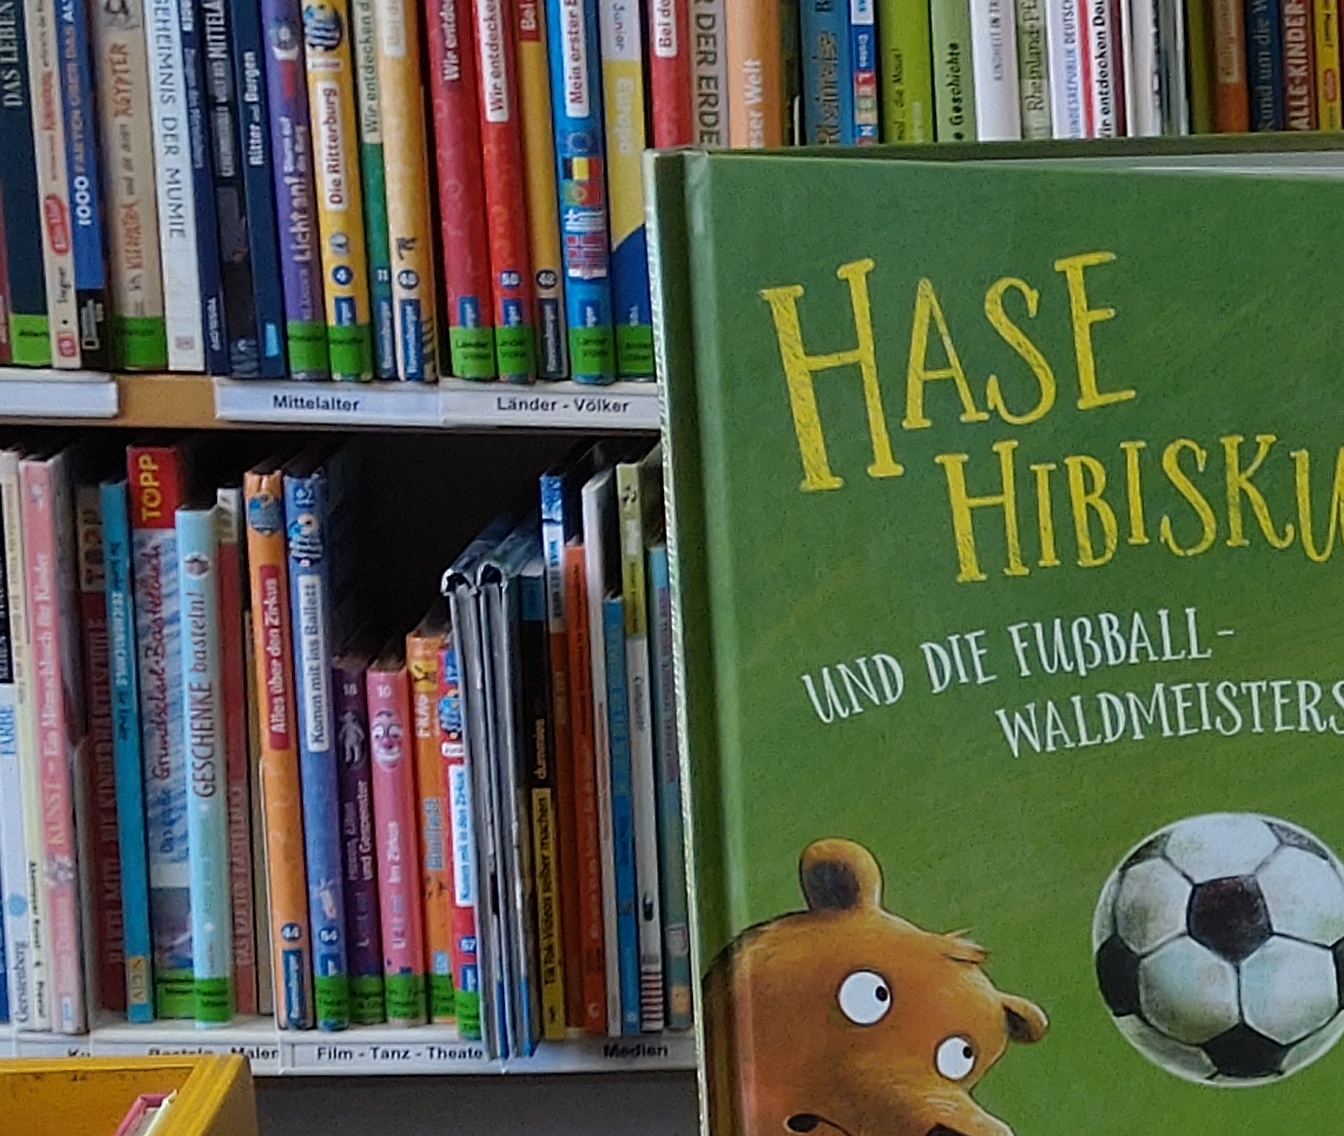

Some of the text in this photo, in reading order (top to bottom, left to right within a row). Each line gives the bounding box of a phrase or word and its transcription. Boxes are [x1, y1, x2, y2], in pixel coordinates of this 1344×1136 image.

[358, 8, 377, 101] entdecken
[444, 57, 460, 82] Wir
[568, 11, 583, 104] Mein erster
[658, 25, 672, 49] Bei
[3, 68, 24, 107] DAS
[490, 83, 505, 112] Wir
[695, 13, 720, 144] DER ERDE
[743, 58, 762, 103] Welt
[947, 43, 964, 126] Geschichte
[1094, 32, 1110, 115] entdecken
[161, 117, 180, 156] DER
[243, 51, 264, 166] Ritter Burgen
[322, 87, 344, 205] Die Ritterburg
[74, 175, 92, 226] 1000
[166, 168, 187, 239] MUMIE
[289, 213, 312, 262] Licht
[273, 394, 360, 411] Mittelalter
[496, 396, 630, 413] Länder Völker
[758, 251, 1136, 492] HASE
[139, 452, 164, 523] TOPP
[263, 578, 287, 733] Alles über den Zirkus
[307, 667, 321, 690] mit
[801, 656, 905, 726] UND
[925, 630, 996, 691] DIE
[185, 592, 216, 798] GESCHENKE basteln!
[43, 779, 65, 845] KUNST
[317, 1047, 353, 1060] Film
[370, 1047, 411, 1060] Tanz
[604, 1045, 669, 1059] Medien
